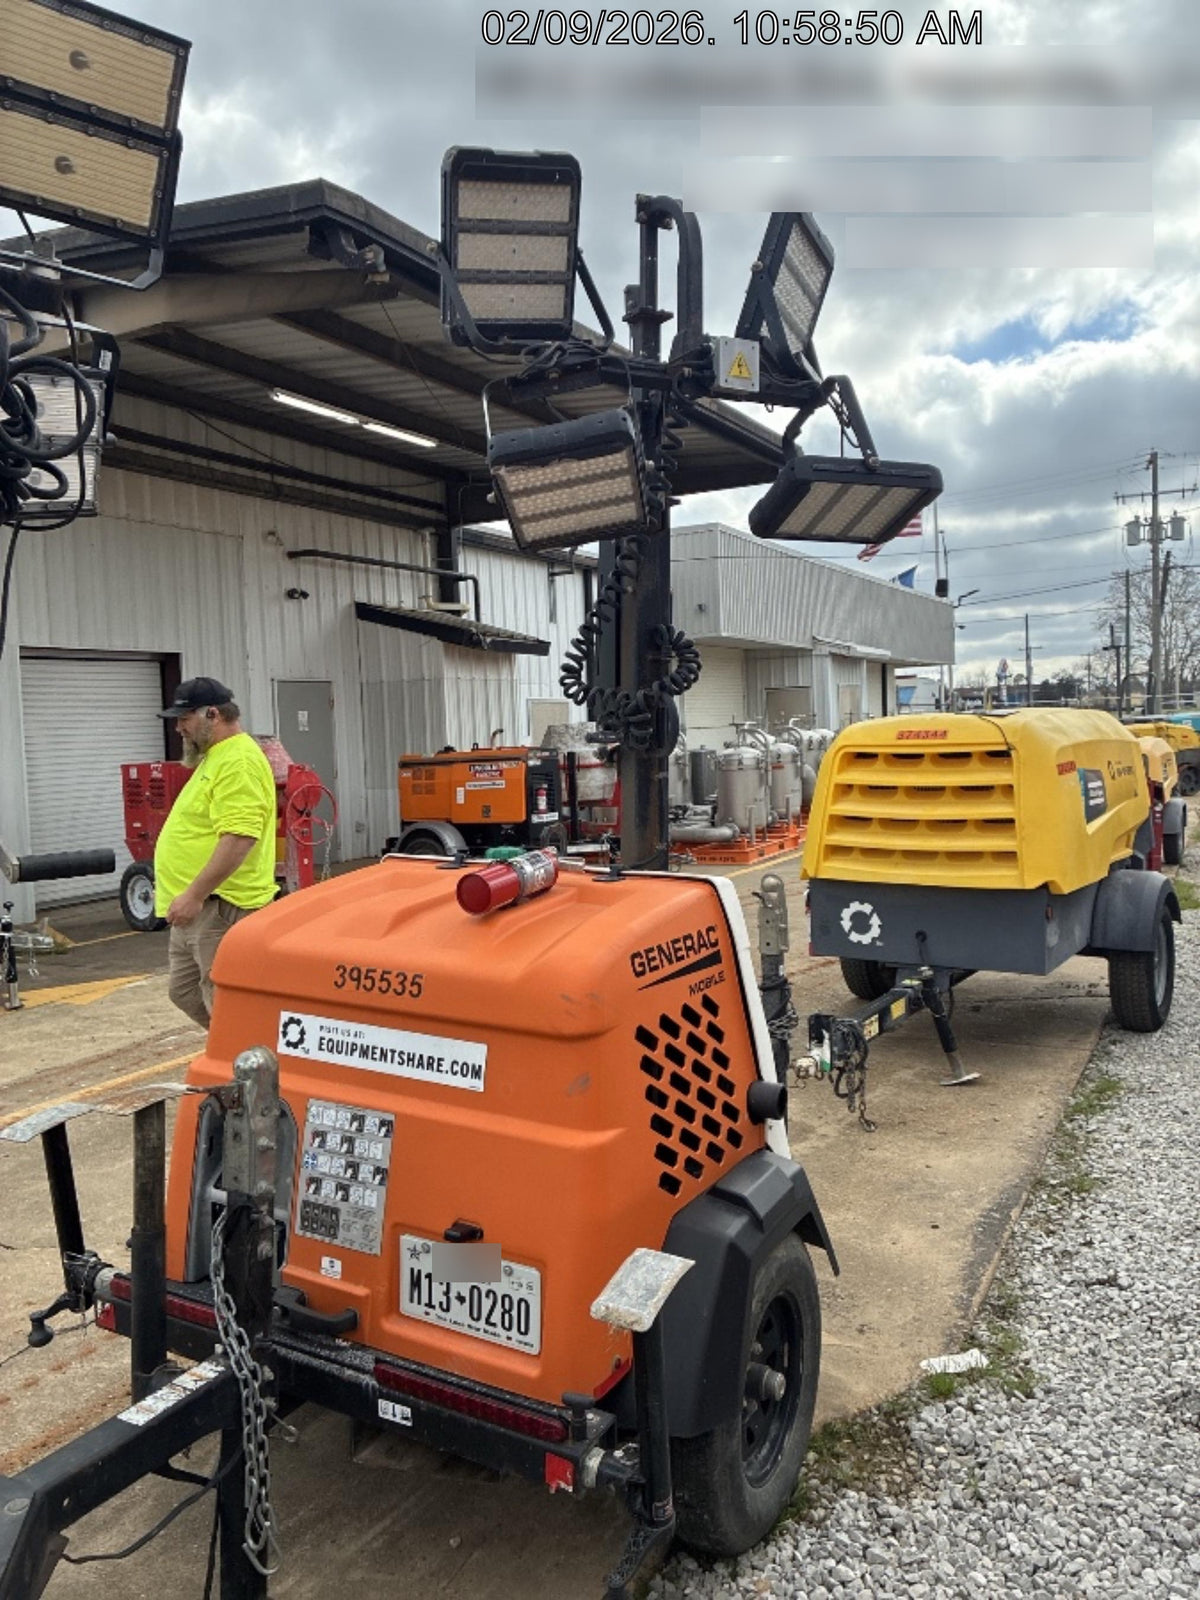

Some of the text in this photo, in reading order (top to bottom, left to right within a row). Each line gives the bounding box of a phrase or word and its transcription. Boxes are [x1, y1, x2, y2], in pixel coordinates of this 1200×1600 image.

[630, 925, 719, 978] GENERAC
[333, 964, 424, 998] 395535
[688, 970, 726, 997] MOBILE
[317, 1035, 483, 1081] EQUIPMENTSHARE.COM
